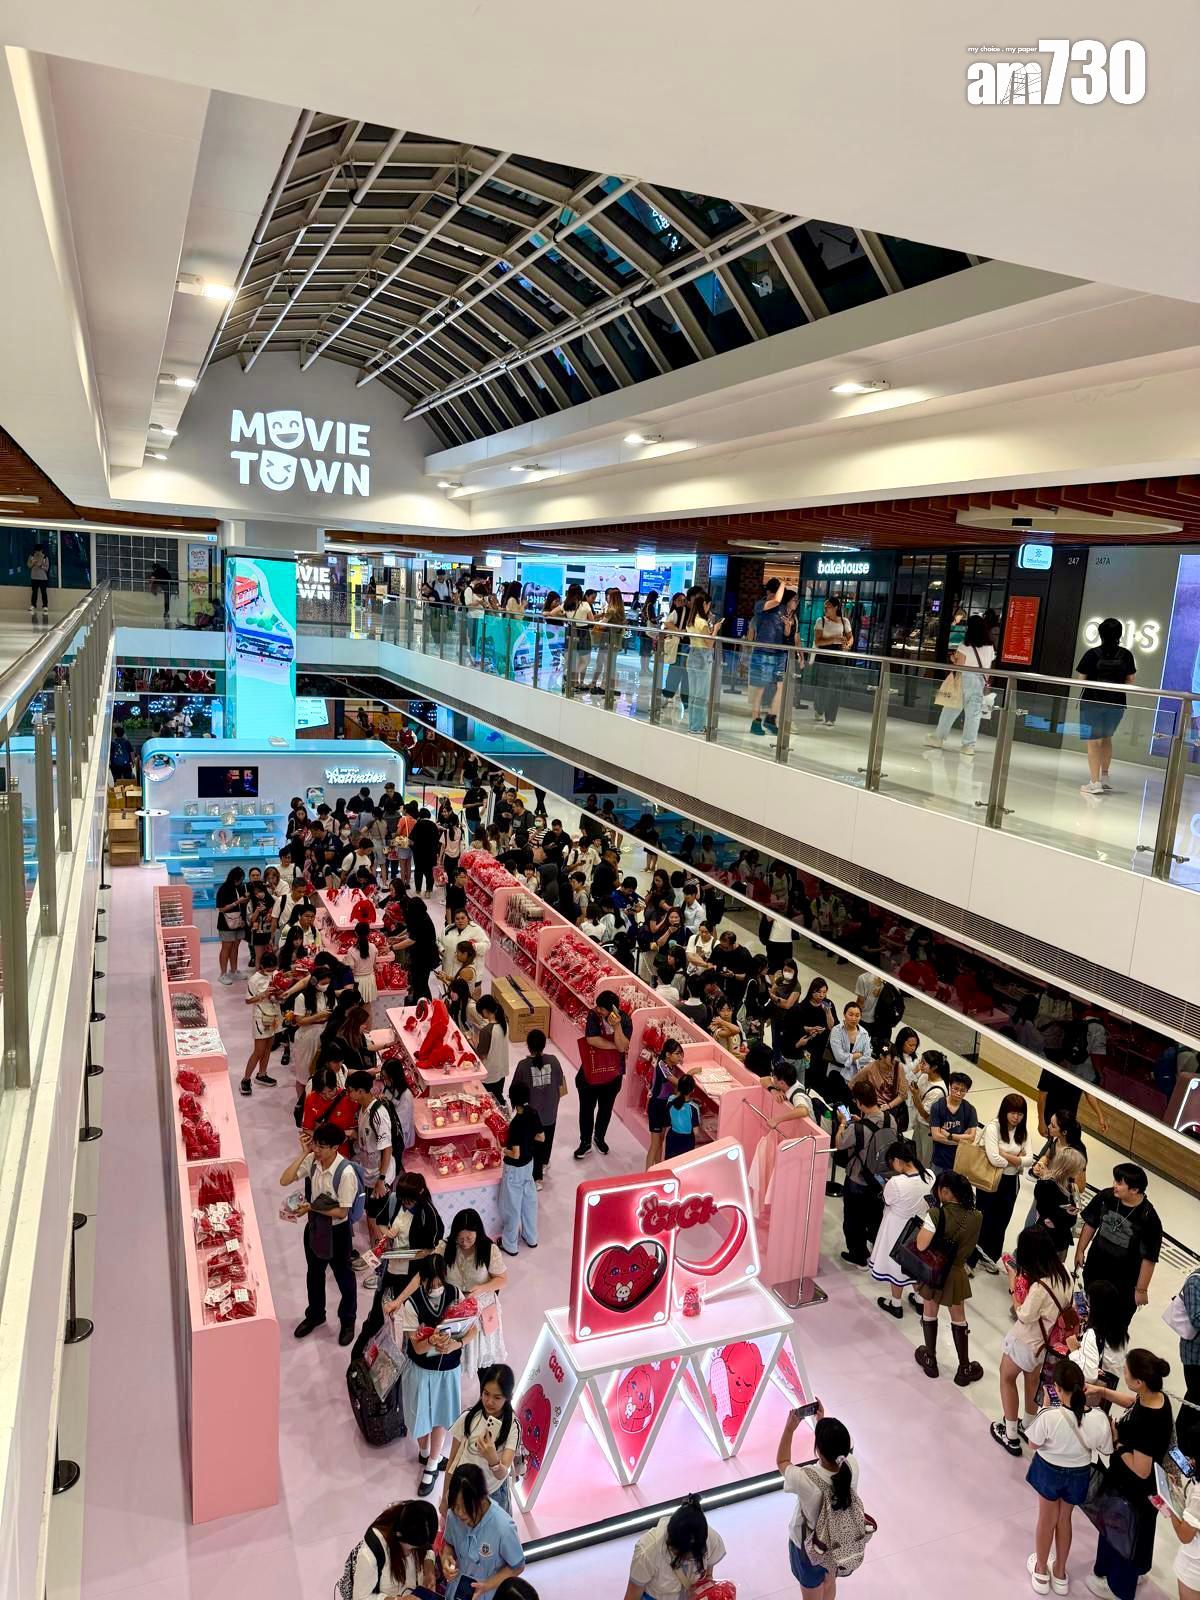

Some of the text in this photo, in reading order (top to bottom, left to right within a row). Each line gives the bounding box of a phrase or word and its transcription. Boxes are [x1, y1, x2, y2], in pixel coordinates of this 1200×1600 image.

[230, 409, 371, 457] MOVIE
[230, 450, 370, 497] TOWN
[817, 559, 870, 574] bakehouse
[1067, 557, 1080, 565] 247
[1095, 557, 1111, 566] 247A
[297, 583, 331, 600] WN
